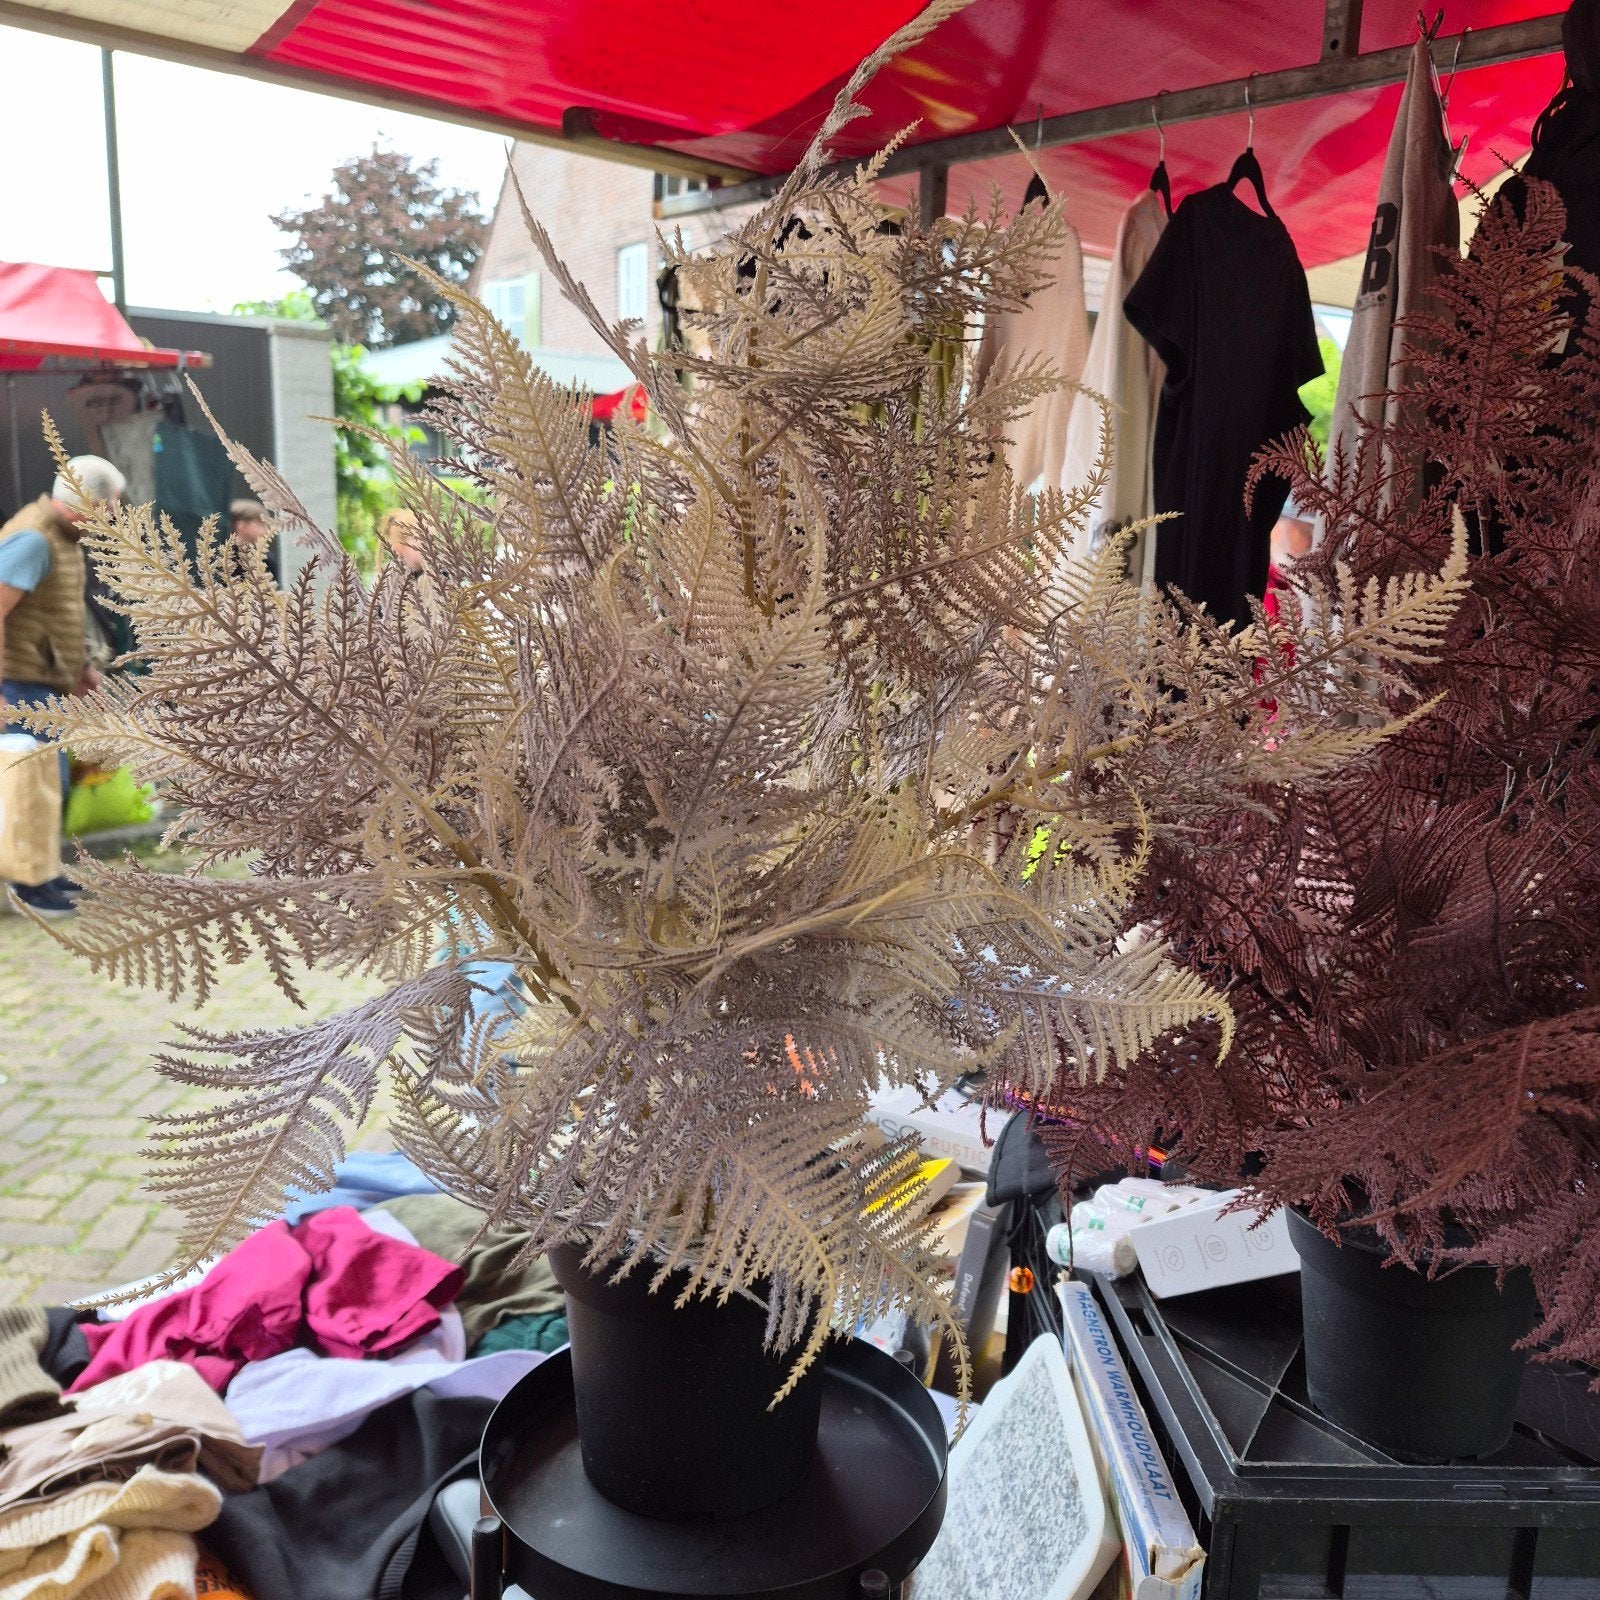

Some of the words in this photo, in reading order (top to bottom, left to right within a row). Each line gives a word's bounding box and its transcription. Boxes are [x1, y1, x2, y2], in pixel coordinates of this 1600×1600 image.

[930, 1136, 987, 1165] RUSTIC
[1075, 1290, 1117, 1367] MAGNETRON
[1106, 1370, 1172, 1500] WARMHOUDPLAAT
